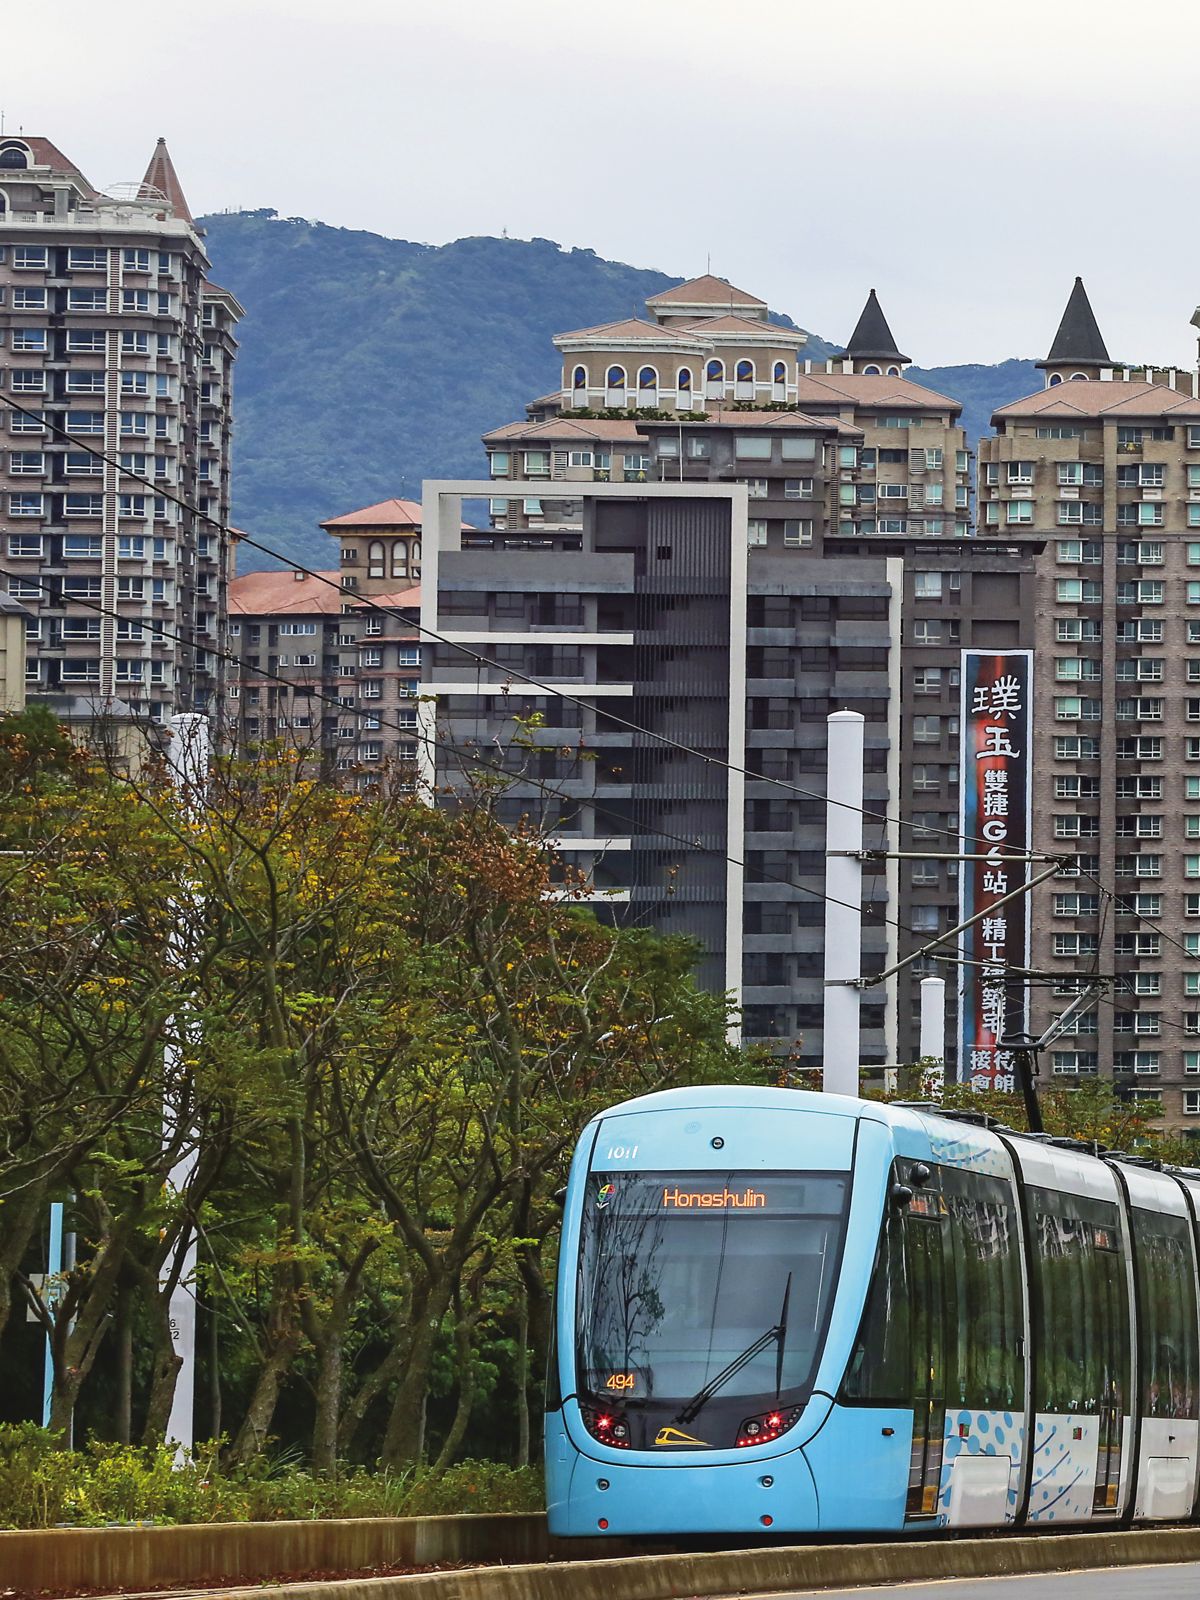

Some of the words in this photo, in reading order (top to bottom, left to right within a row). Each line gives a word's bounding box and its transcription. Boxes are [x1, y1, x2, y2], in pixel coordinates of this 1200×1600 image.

[971, 674, 1022, 759] 璞玉
[663, 1188, 766, 1207] Hongshulin
[606, 1373, 635, 1390] 494
